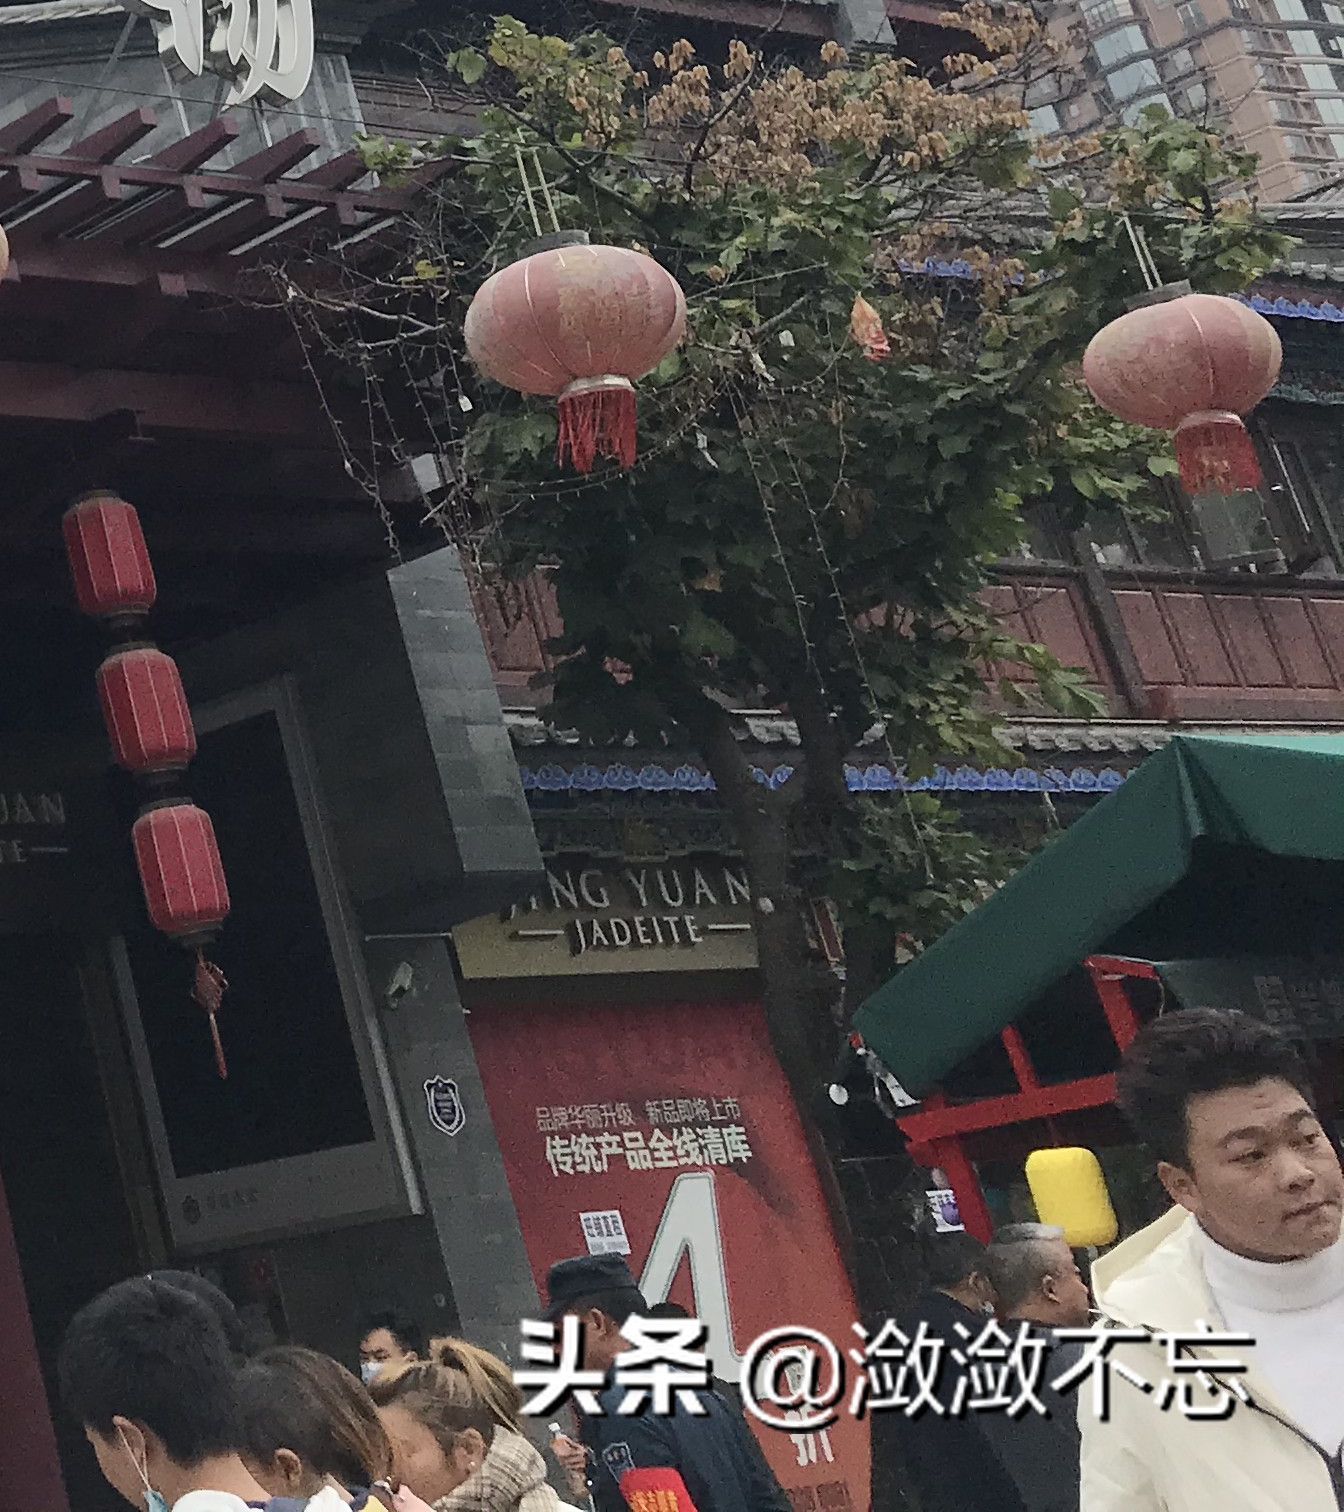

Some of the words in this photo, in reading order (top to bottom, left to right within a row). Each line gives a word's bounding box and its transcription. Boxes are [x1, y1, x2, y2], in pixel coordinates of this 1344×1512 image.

[626, 866, 752, 908] YUAN
[573, 915, 705, 954] JADEITE
[645, 1095, 741, 1125] 新品即将上市
[545, 1123, 753, 1177] 传统产品全线清库
